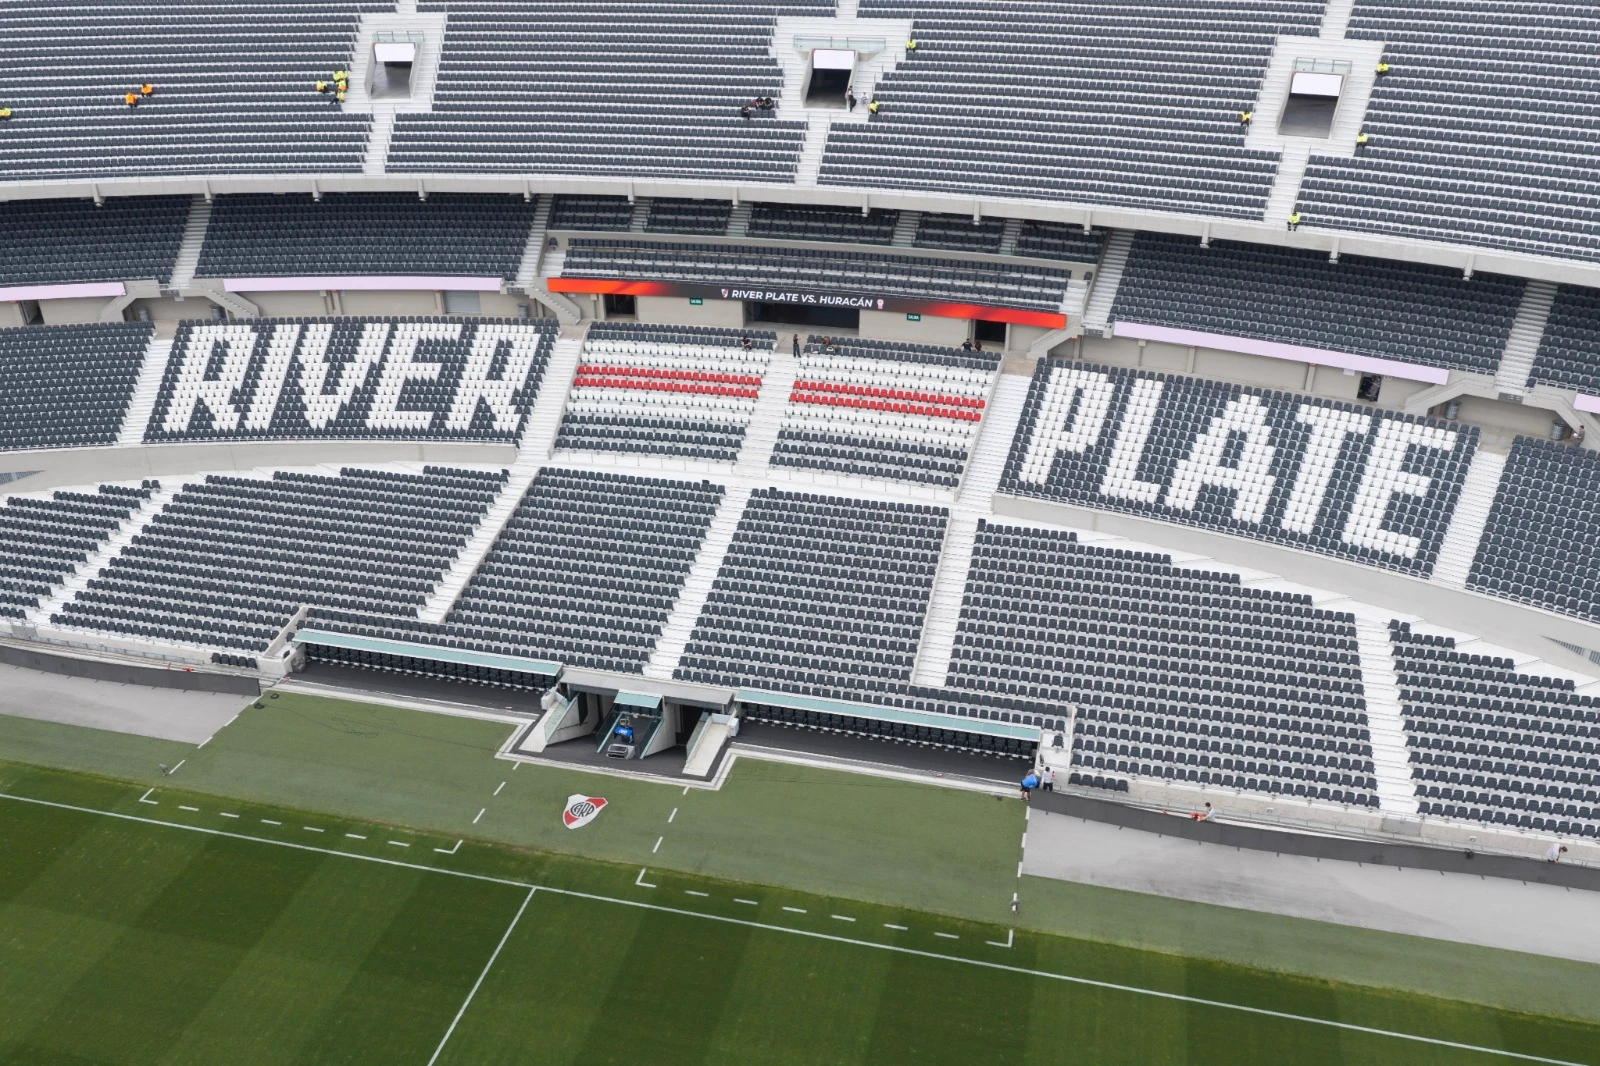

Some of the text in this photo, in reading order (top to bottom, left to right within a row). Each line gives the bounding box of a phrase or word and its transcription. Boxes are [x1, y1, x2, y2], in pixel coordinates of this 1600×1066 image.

[731, 289, 873, 307] RIVER PLATE VS. HURACÁN
[162, 323, 1456, 558] RIVER PLATE
